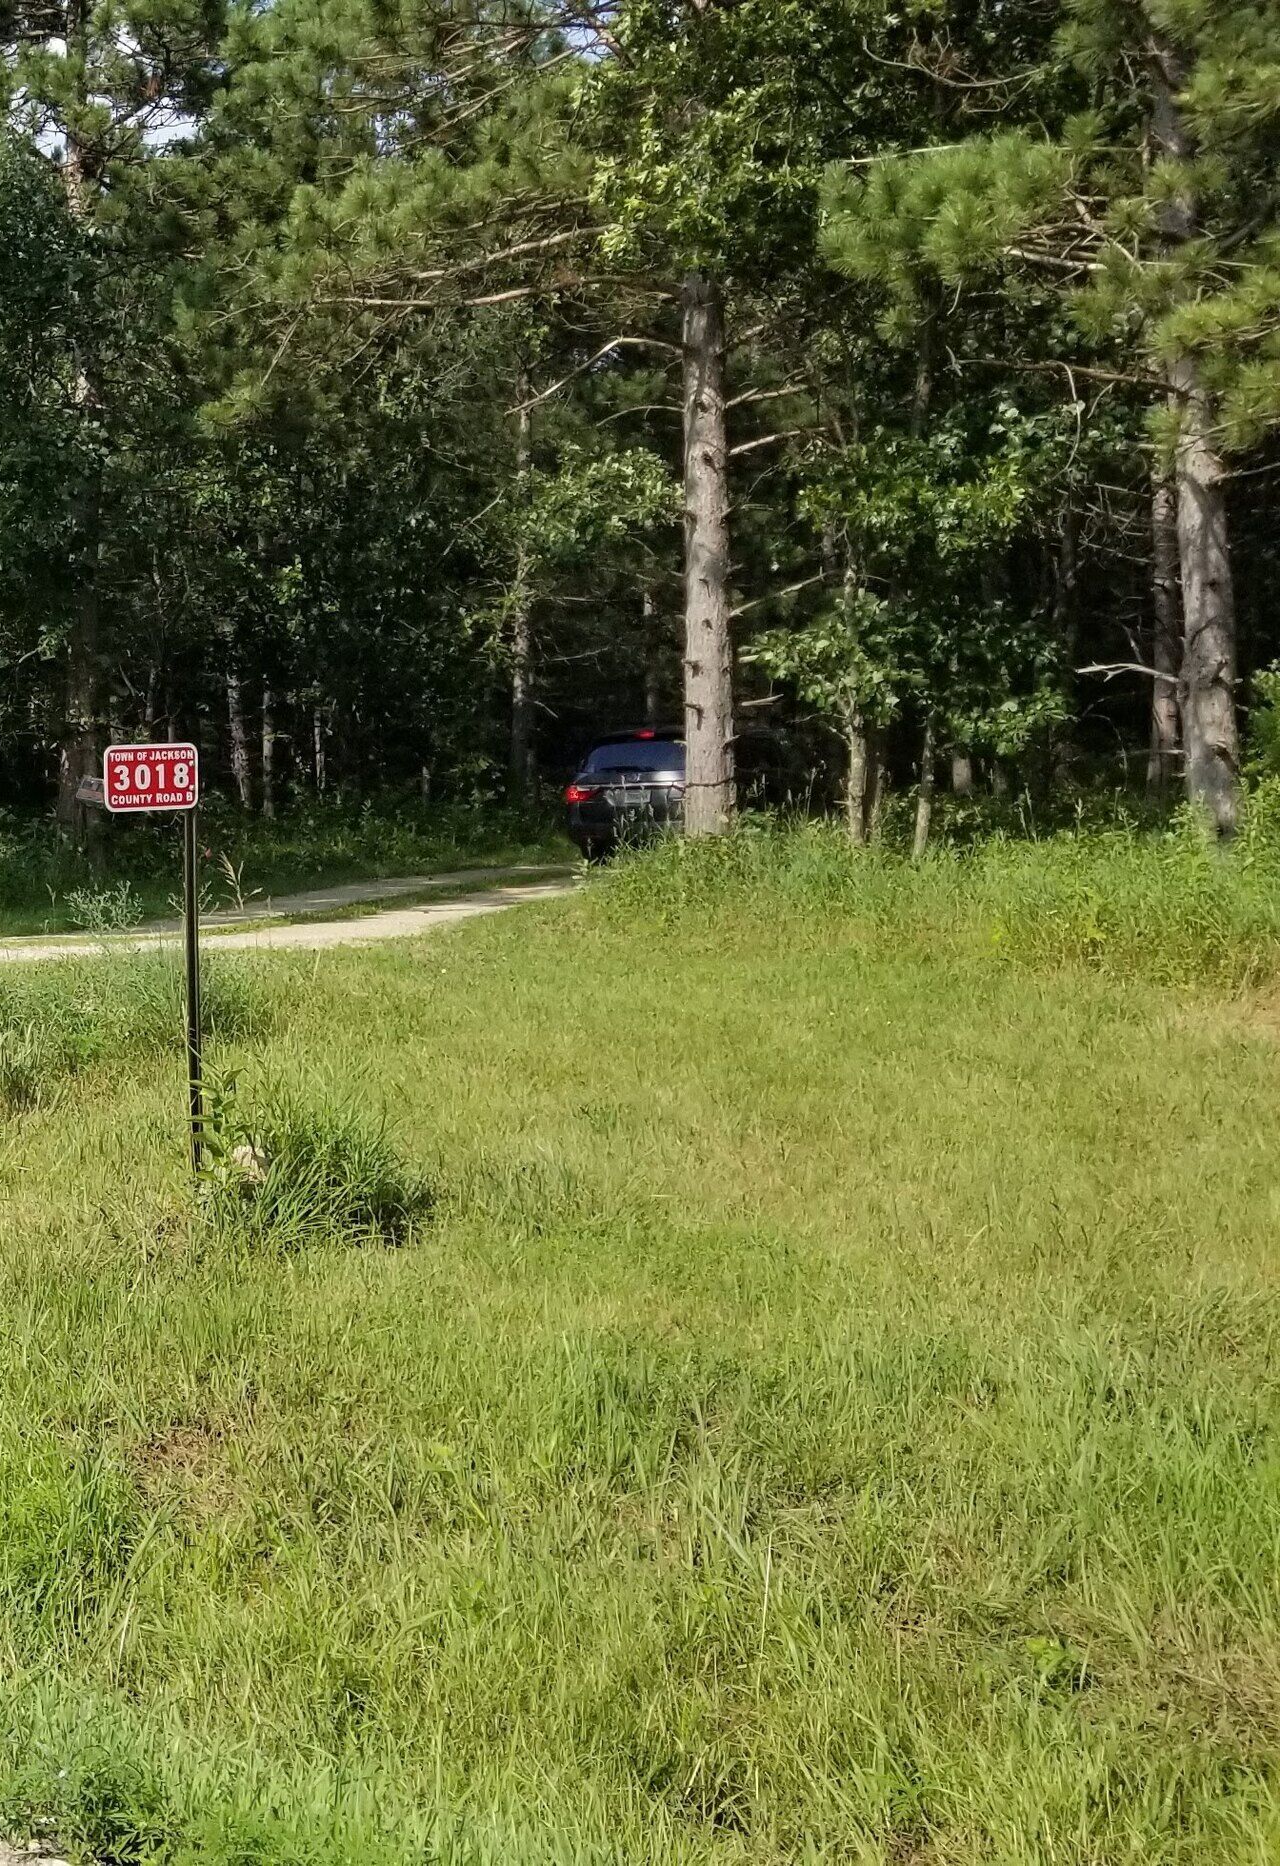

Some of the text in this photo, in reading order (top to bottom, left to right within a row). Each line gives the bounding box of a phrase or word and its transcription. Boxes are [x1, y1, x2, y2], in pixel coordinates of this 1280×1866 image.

[110, 750, 194, 762] TOWN OF JACKSON
[113, 763, 189, 790] 3018
[111, 791, 193, 805] COUNTY ROAD B
